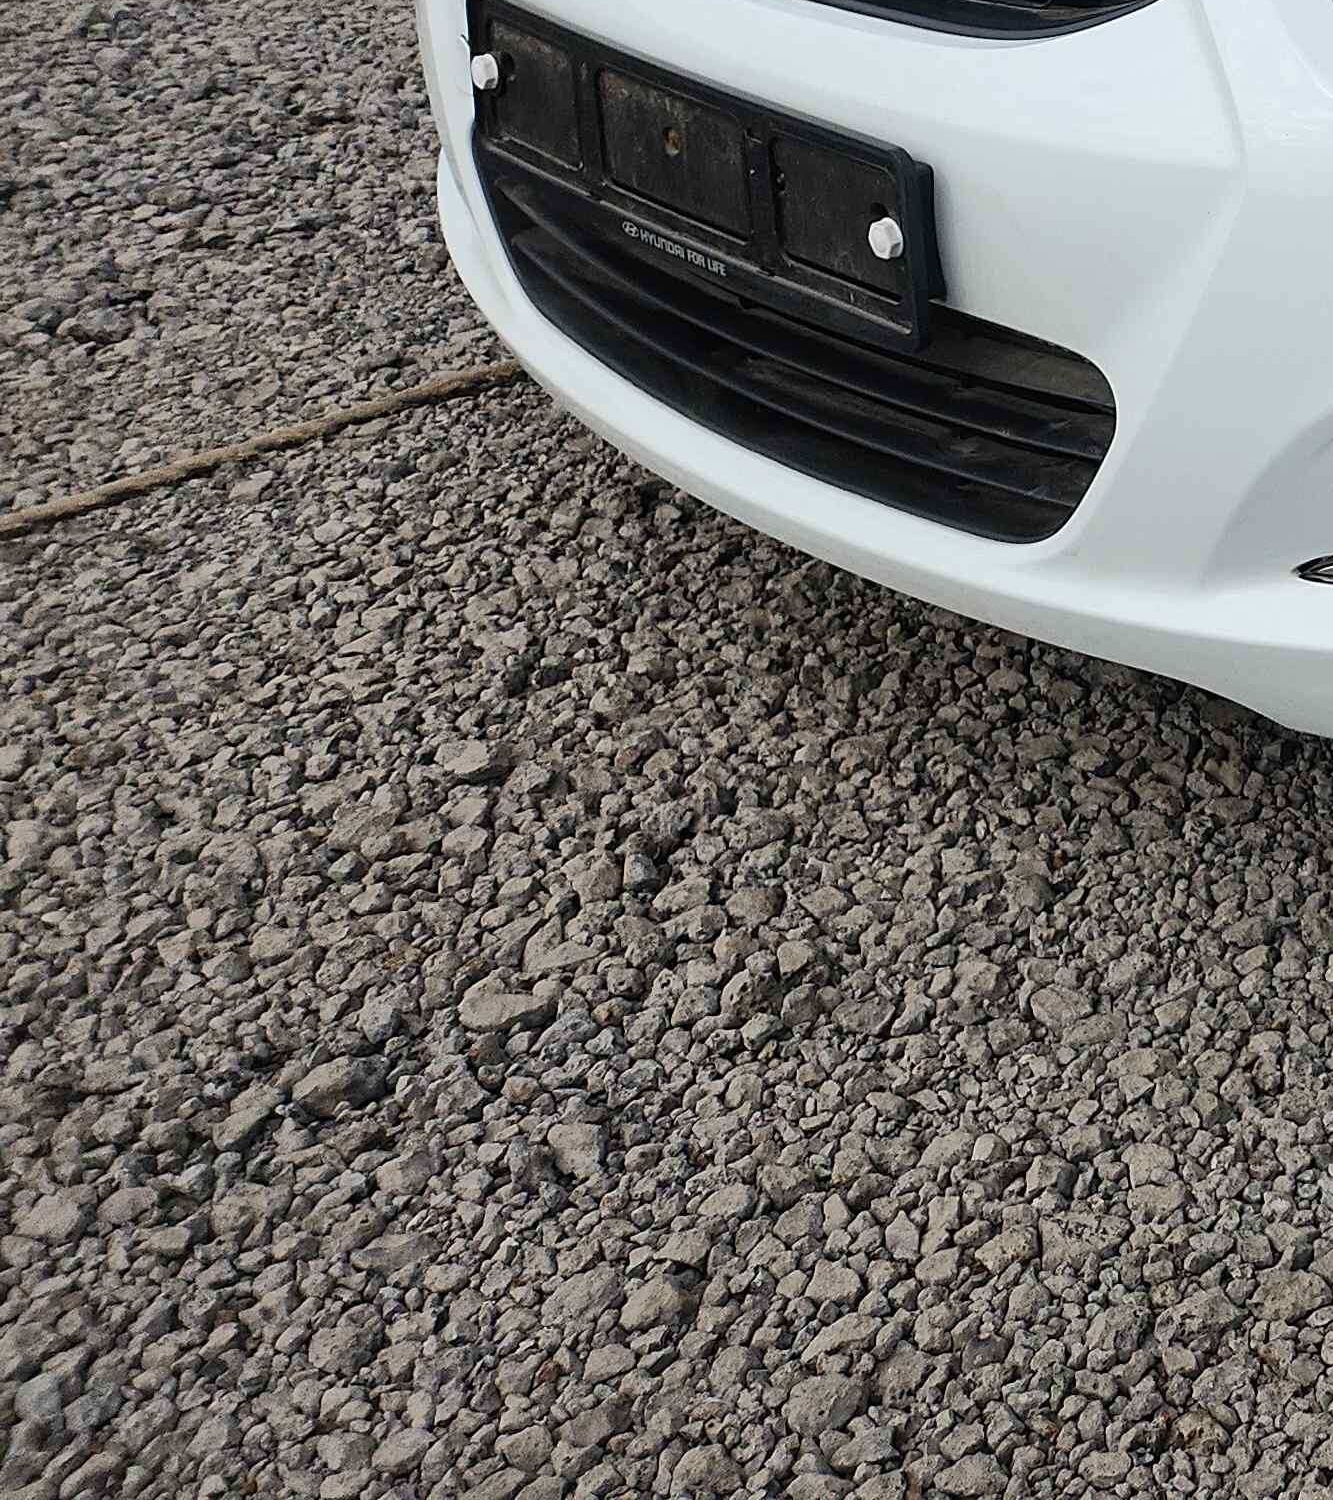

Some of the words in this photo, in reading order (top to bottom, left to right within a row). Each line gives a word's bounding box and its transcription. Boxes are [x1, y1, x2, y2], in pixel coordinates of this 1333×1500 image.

[640, 228, 685, 260] HYUNDAI
[687, 248, 706, 269] FOR
[707, 257, 727, 277] LIFE
